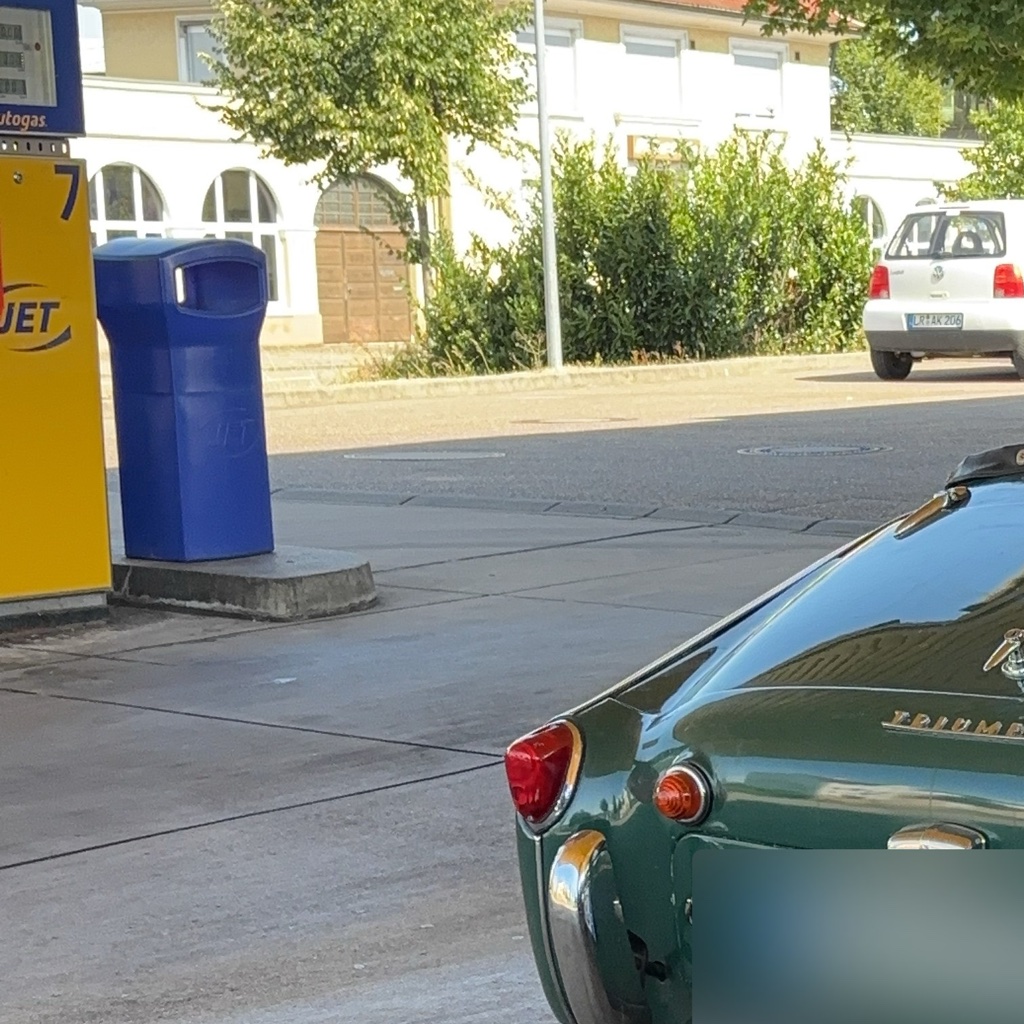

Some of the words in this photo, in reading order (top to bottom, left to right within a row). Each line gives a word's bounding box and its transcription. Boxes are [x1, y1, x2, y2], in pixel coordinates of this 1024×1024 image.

[0, 110, 47, 132] utogas
[55, 164, 80, 221] 7
[0, 301, 61, 335] JET
[913, 315, 925, 326] LR
[931, 315, 942, 326] AK
[944, 315, 962, 326] 206
